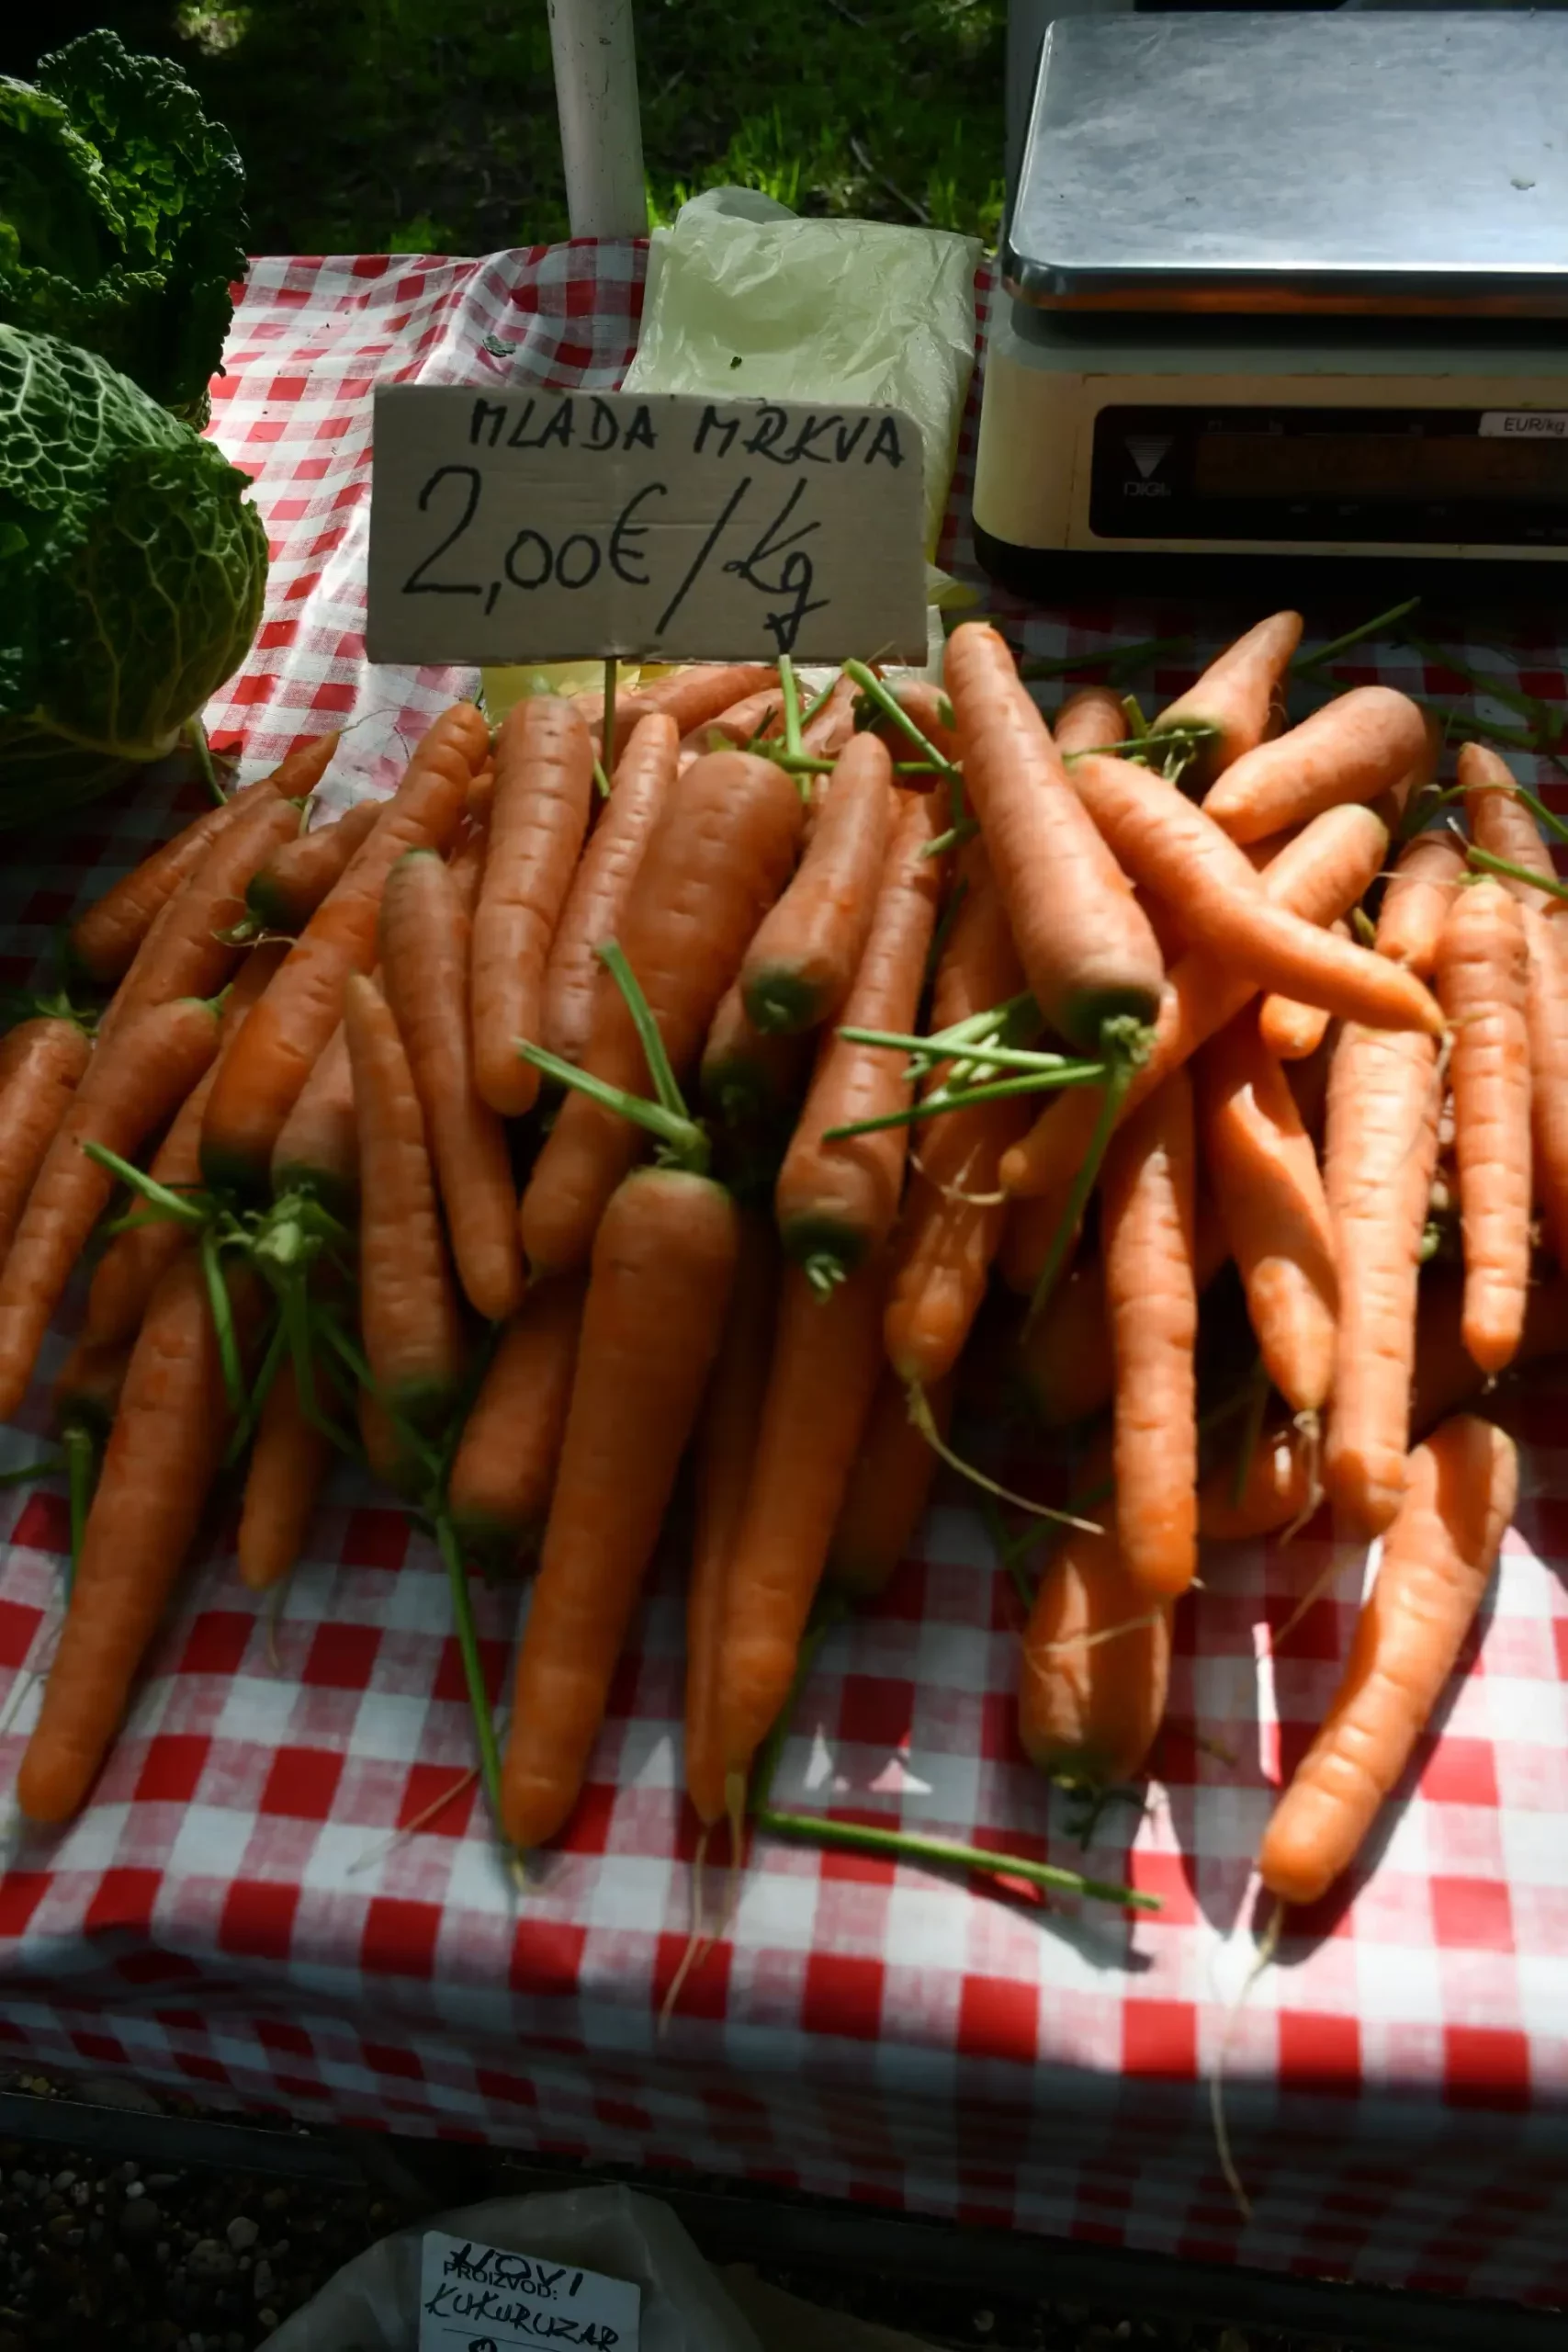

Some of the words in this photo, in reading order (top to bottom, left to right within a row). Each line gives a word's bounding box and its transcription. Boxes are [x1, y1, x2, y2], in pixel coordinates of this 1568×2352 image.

[469, 396, 658, 451] MLADA
[694, 400, 905, 469] MRKVA
[1504, 416, 1565, 435] EUR/kg
